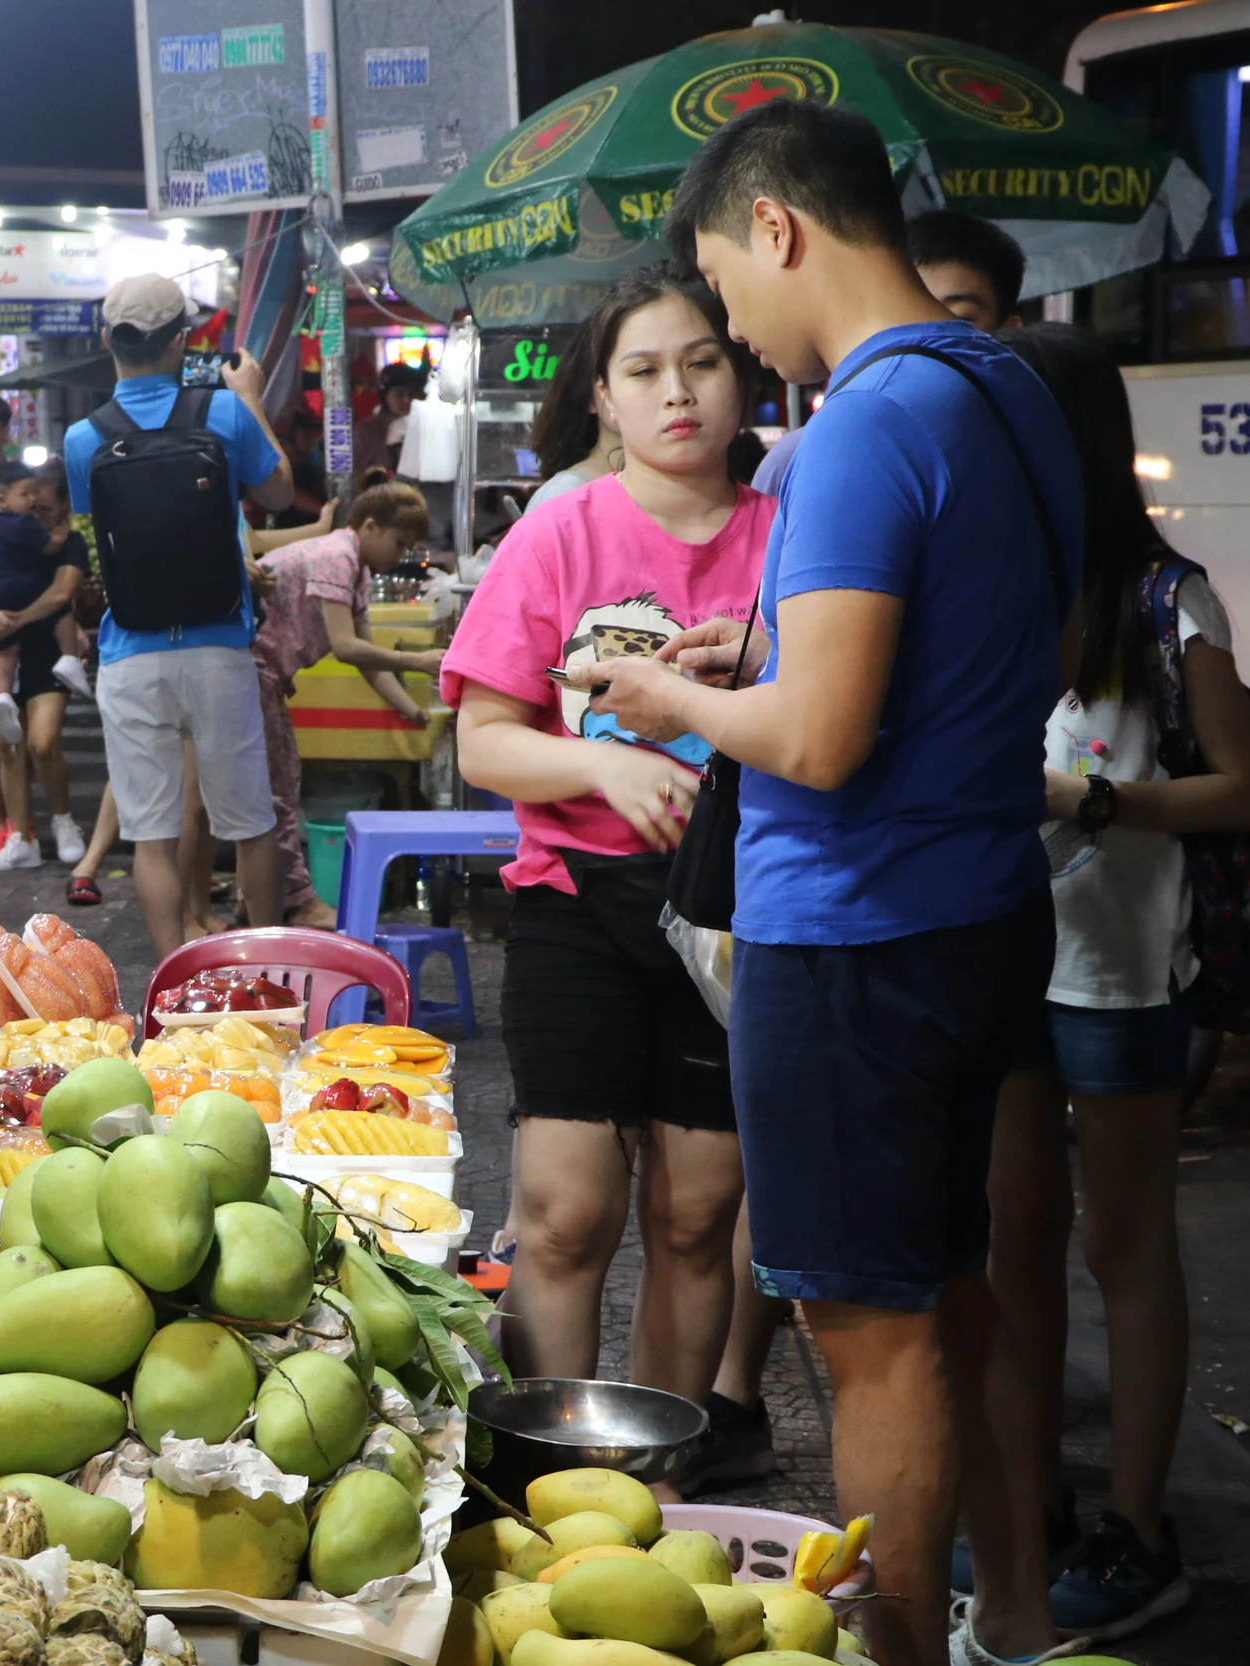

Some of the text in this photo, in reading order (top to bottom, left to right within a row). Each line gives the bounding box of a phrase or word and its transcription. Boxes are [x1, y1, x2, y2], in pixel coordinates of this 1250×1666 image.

[367, 58, 428, 87] 0932676880
[355, 175, 381, 193] GUIDO
[941, 163, 1152, 207] SECURITY CQN
[422, 195, 575, 268] SECURITY CQN
